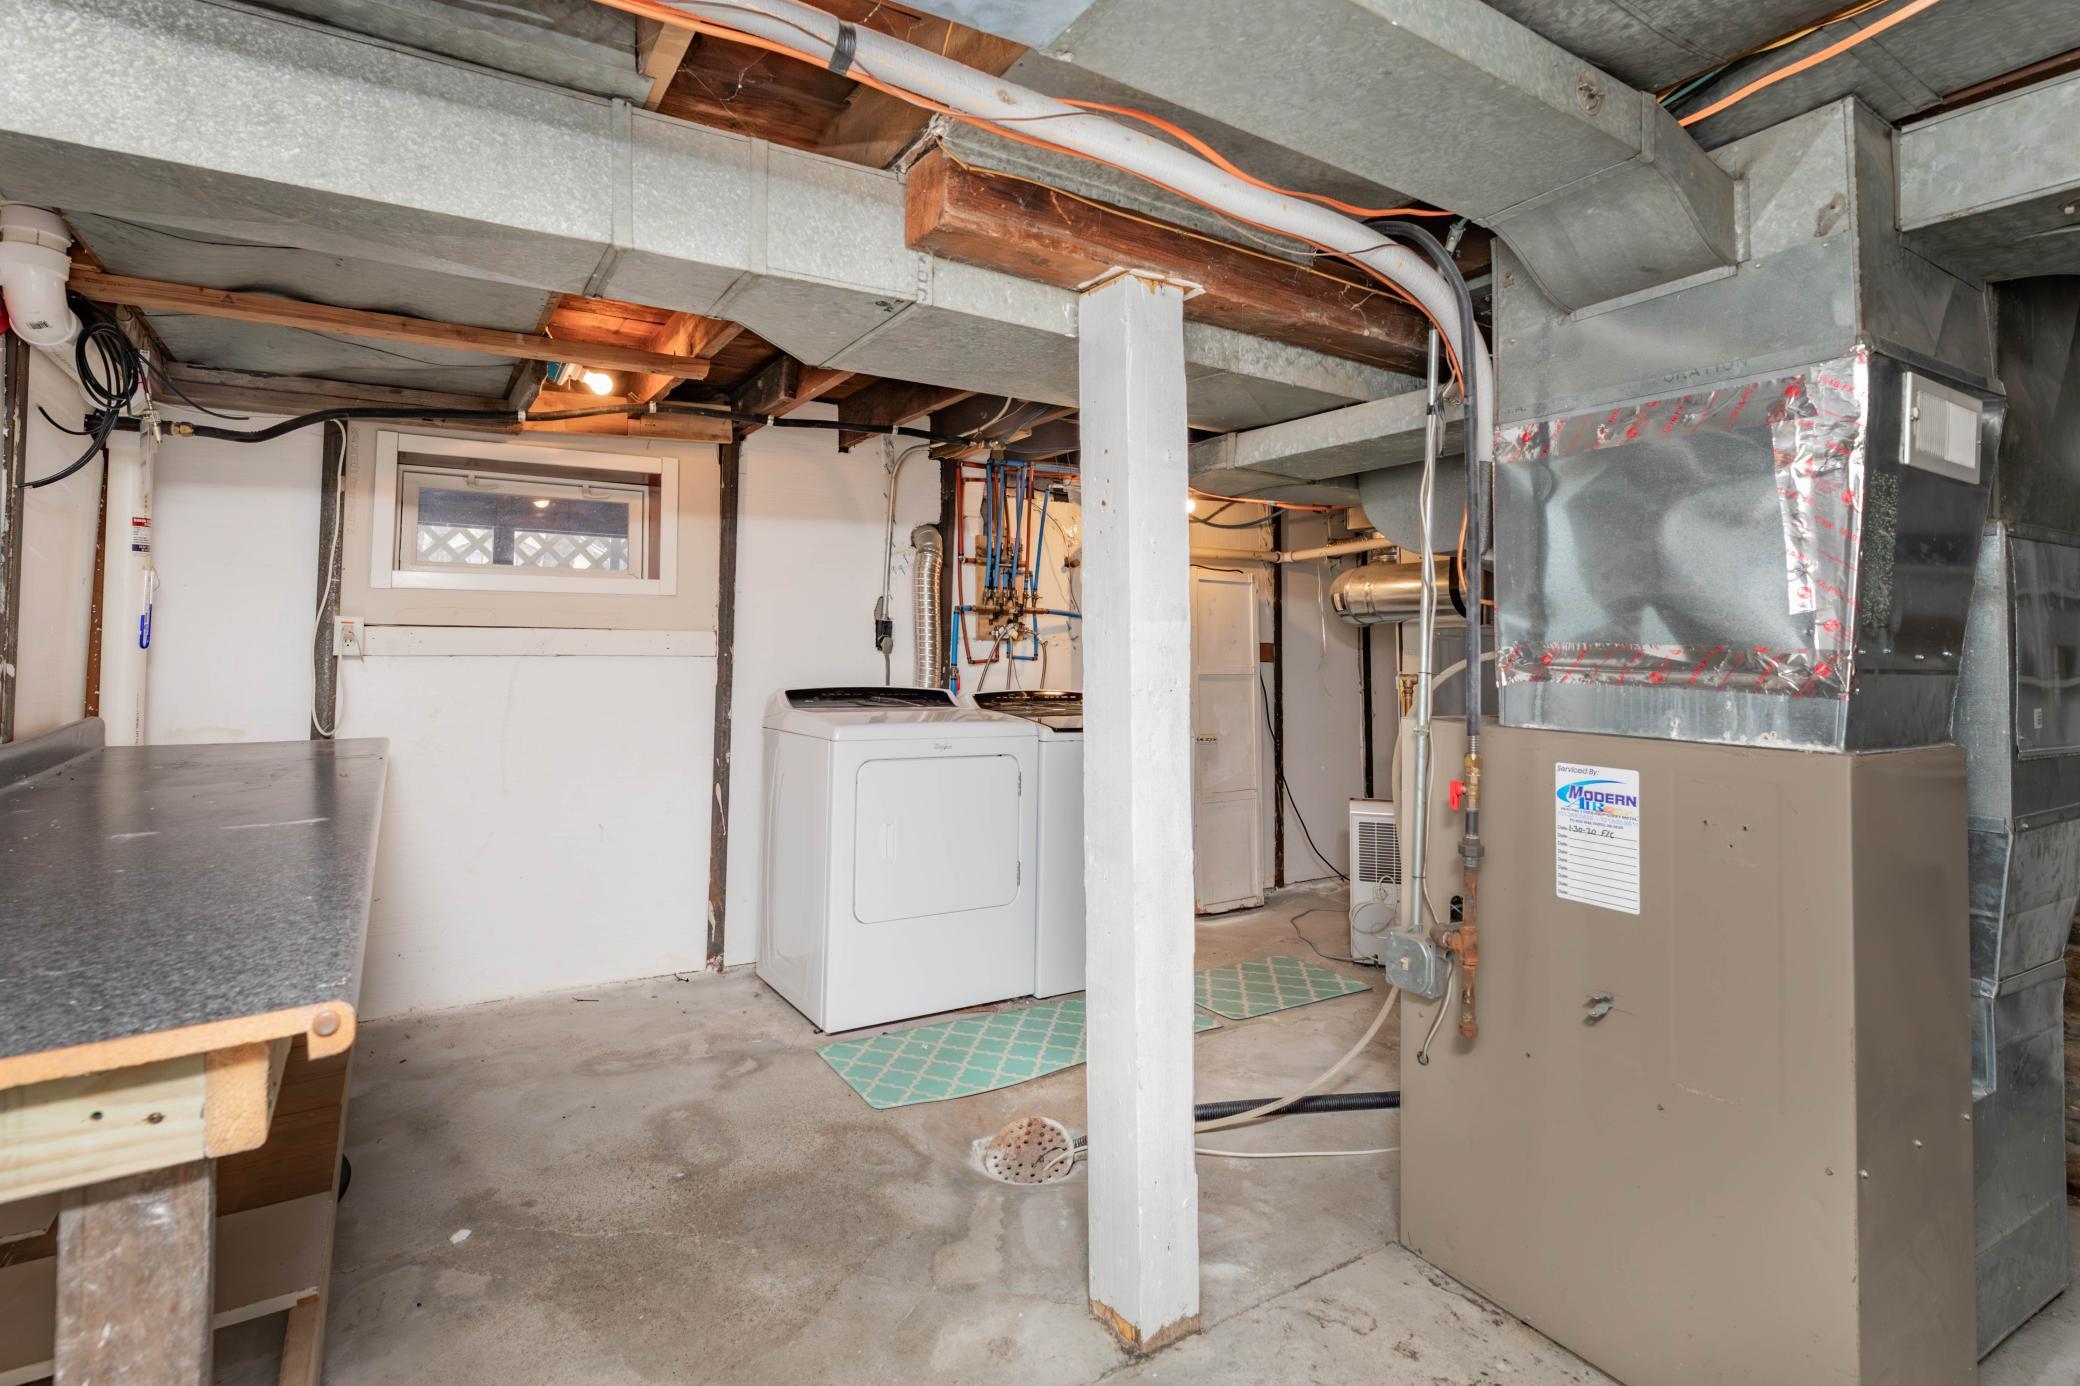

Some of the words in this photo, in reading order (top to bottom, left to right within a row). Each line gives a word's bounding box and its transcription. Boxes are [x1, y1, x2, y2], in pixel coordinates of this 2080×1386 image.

[1557, 765, 1588, 775] Serviced
[1588, 767, 1600, 776] By:
[1568, 783, 1637, 808] MODERN
